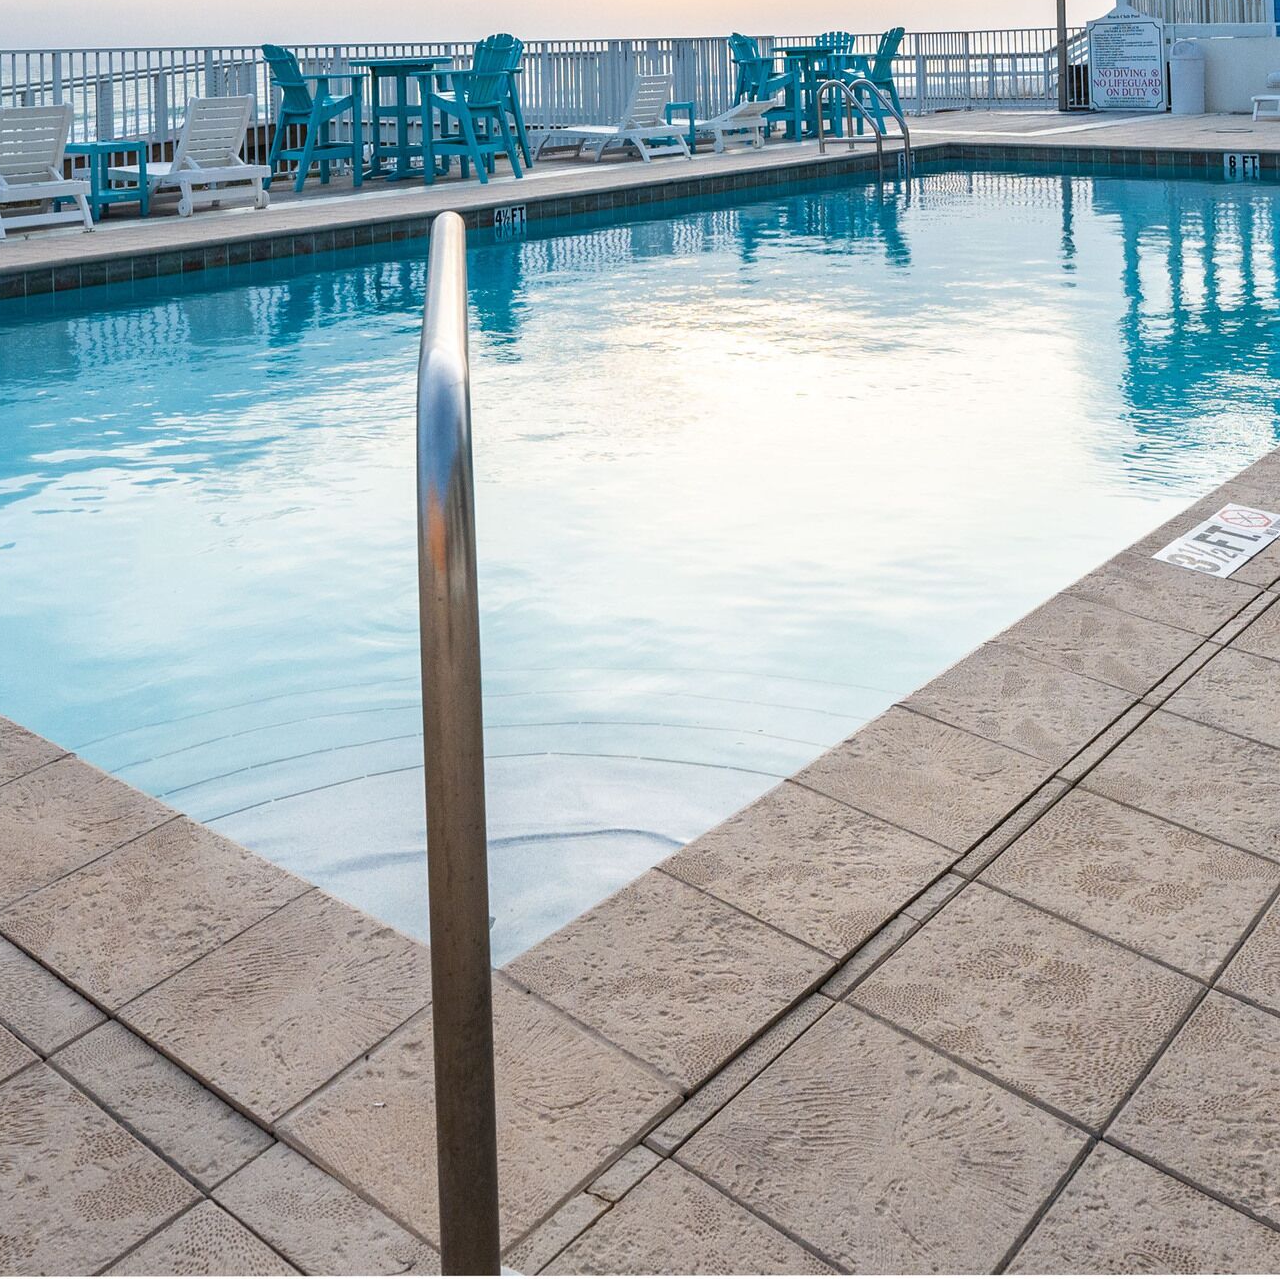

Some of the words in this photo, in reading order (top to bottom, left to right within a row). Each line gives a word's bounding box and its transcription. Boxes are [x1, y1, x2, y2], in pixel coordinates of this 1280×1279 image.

[1098, 69, 1111, 77] NO
[1114, 69, 1146, 77] DIVING
[1094, 79, 1106, 87] NO
[1109, 79, 1161, 87] LIFEGUARD
[1106, 88, 1120, 96] ON
[1122, 88, 1147, 96] DUTY
[1228, 155, 1236, 168] 6
